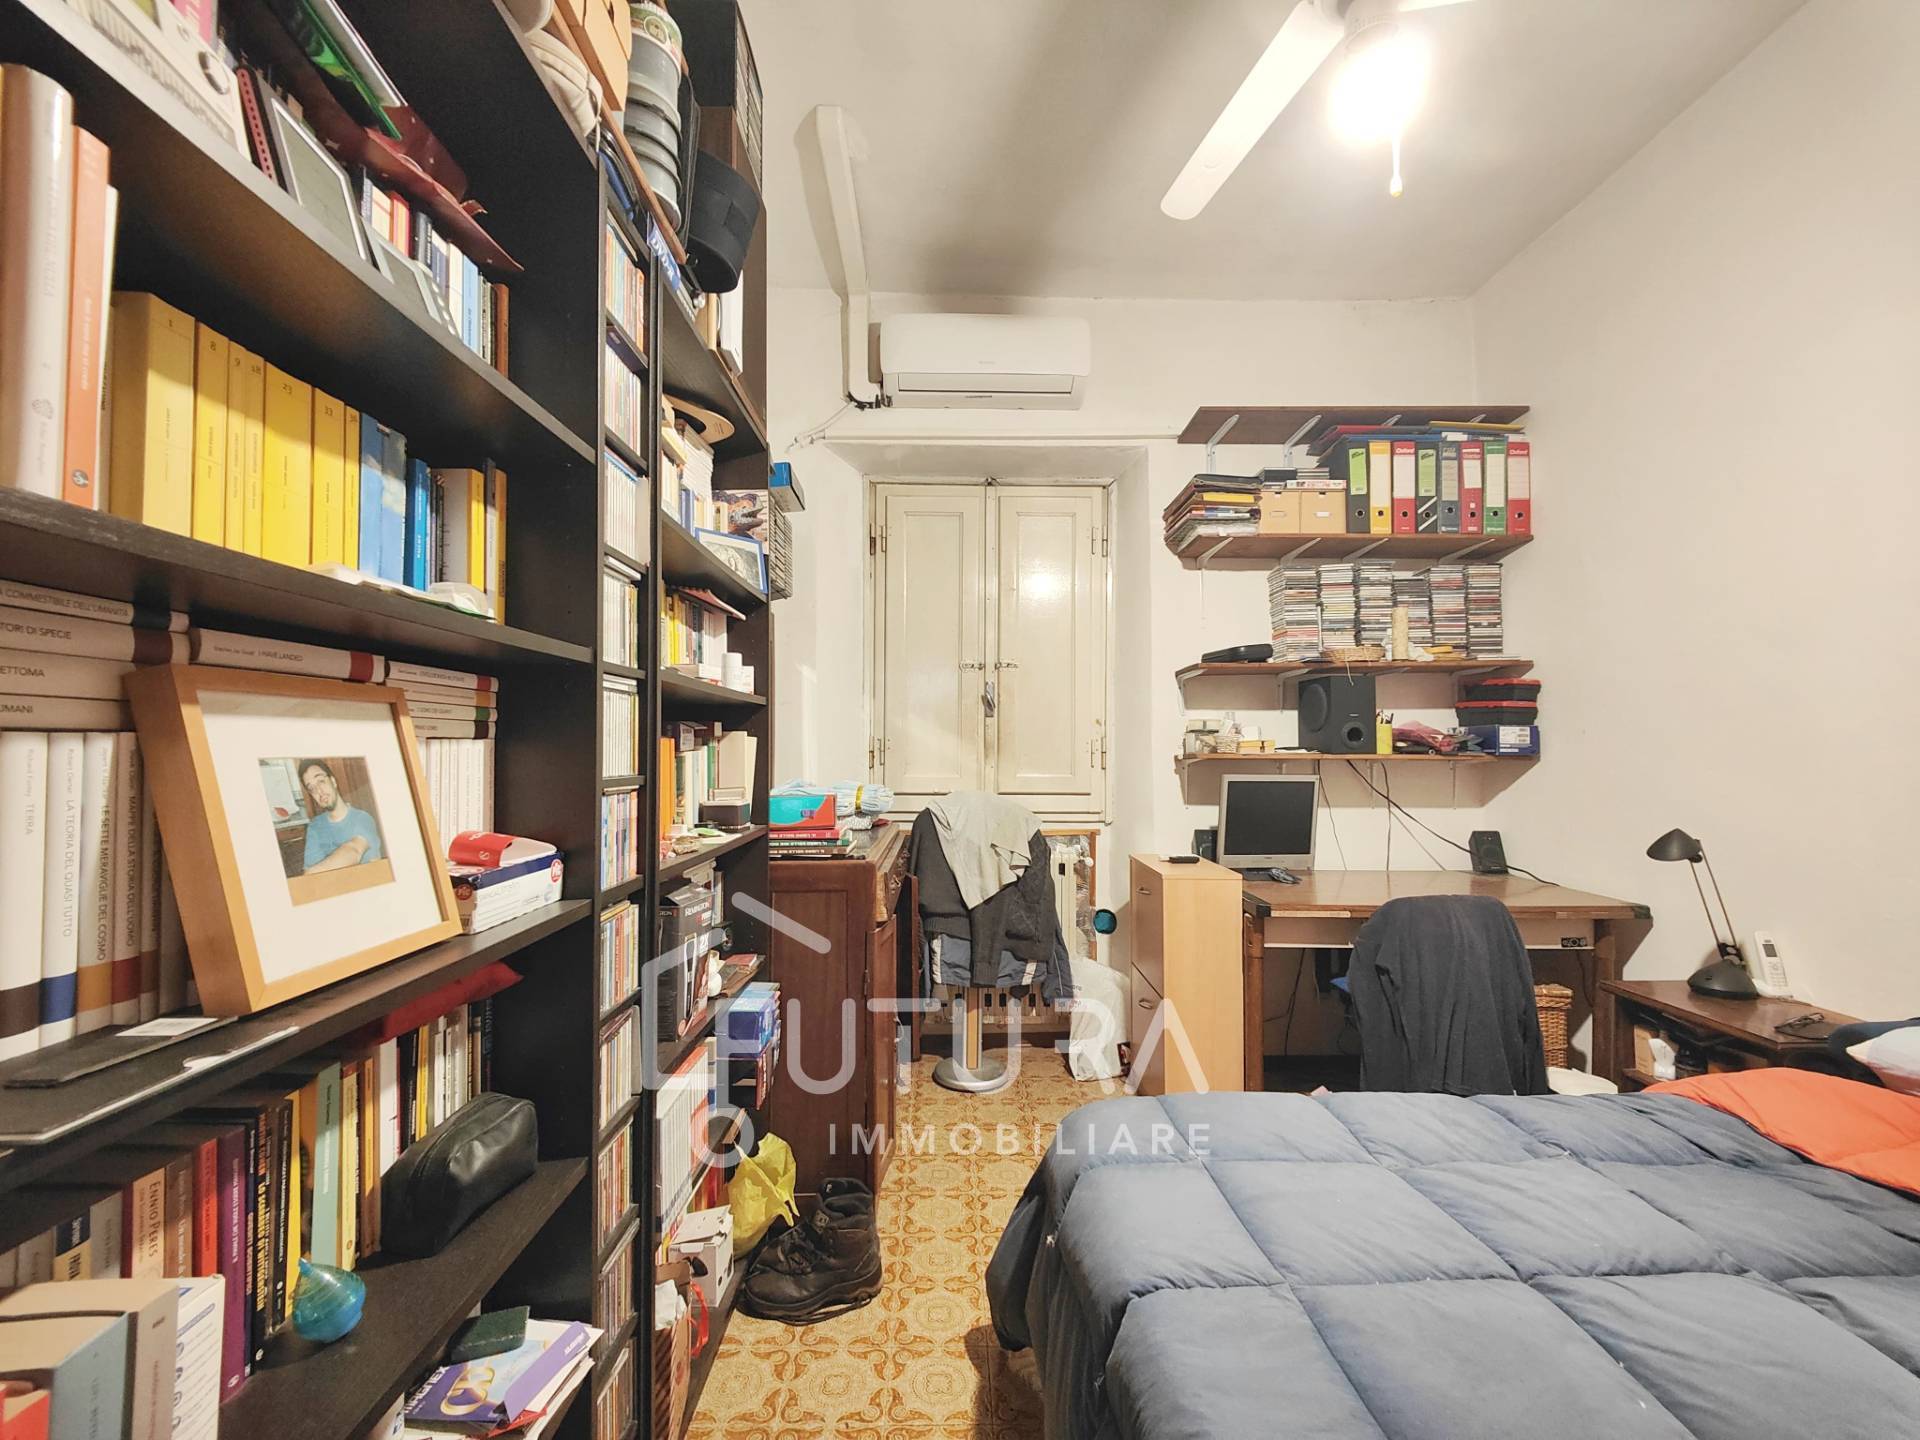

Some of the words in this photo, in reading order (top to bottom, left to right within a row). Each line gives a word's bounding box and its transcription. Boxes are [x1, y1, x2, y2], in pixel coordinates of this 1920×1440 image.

[38, 627, 72, 640] SPECIE
[25, 803, 34, 836] TERRA
[65, 800, 75, 812] LA
[127, 796, 136, 827] MAPPE
[65, 815, 74, 849] TEORIA
[100, 818, 110, 846] SETTE
[127, 829, 136, 857] DELLA
[64, 851, 74, 870] DEL
[98, 847, 109, 902] MERAVIGLIE
[127, 859, 136, 891] STORIA
[63, 872, 73, 903] QUASI
[63, 905, 73, 937] TUTTO
[97, 904, 108, 922] DEL
[96, 924, 107, 961] COSMO
[149, 1180, 161, 1220] ENNIO
[257, 1181, 266, 1194] LO
[256, 1195, 266, 1240] SCARABEO
[149, 1220, 161, 1257] PERES
[256, 1251, 266, 1311] WITTGENSTEIN
